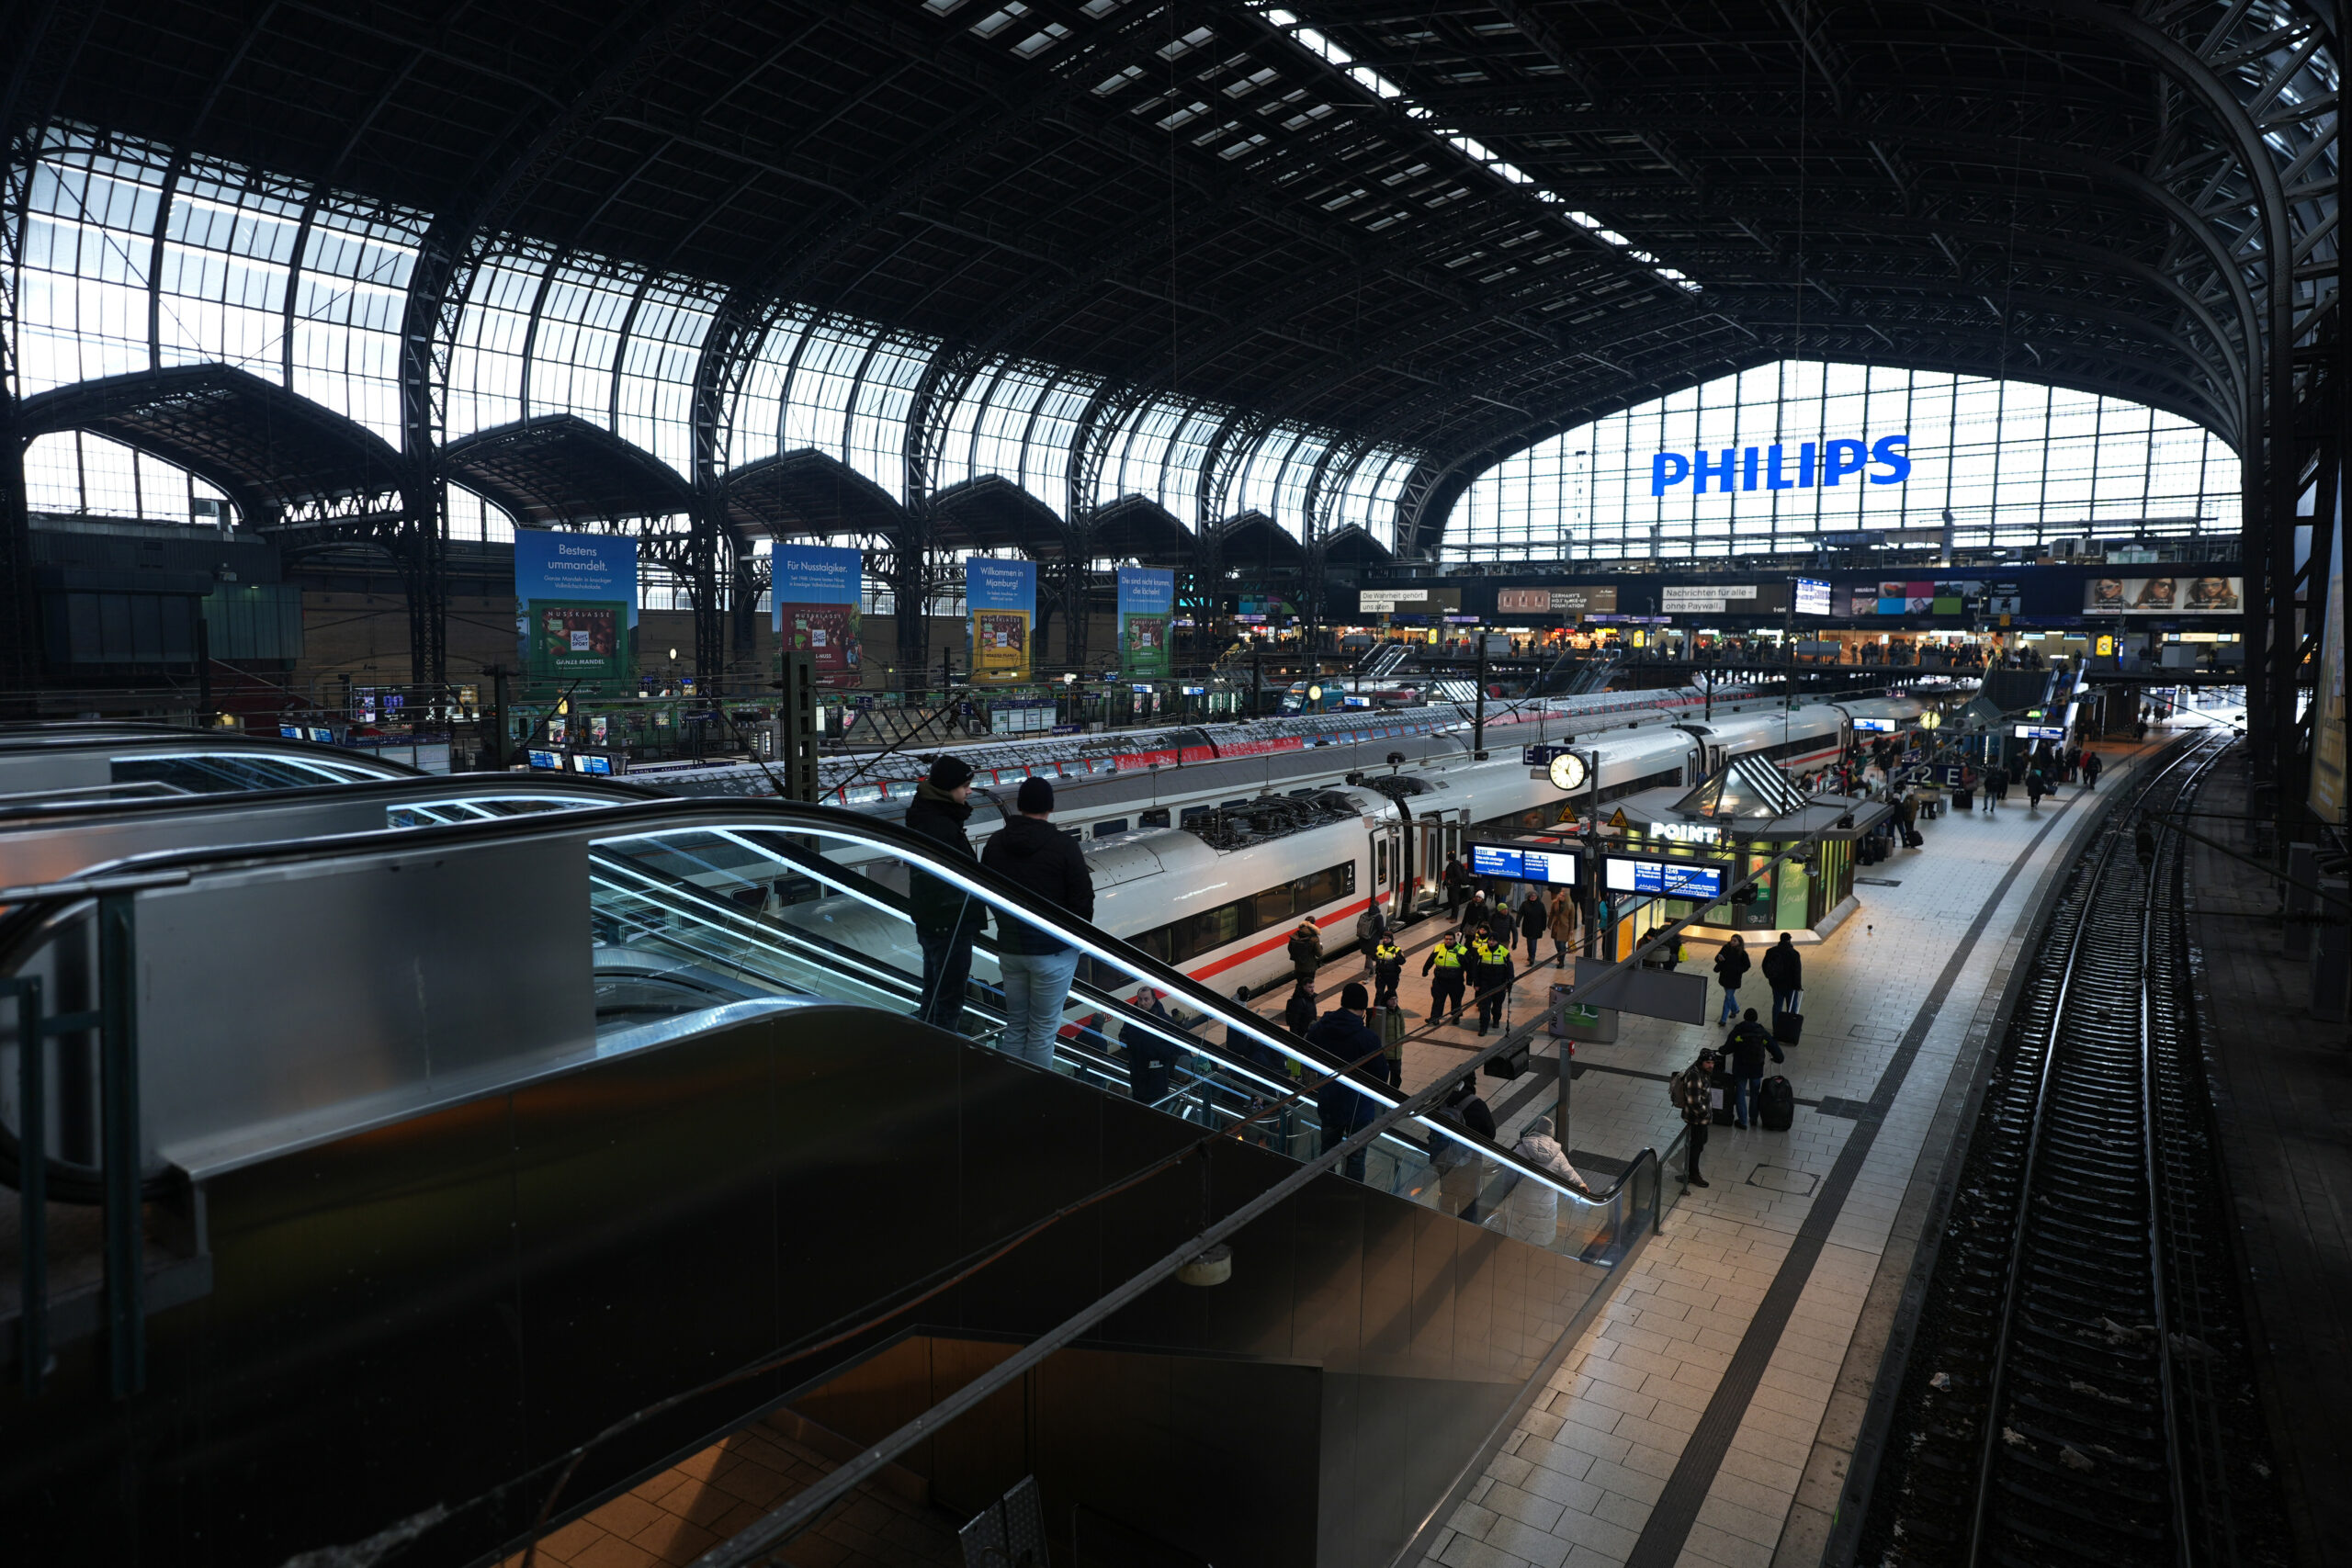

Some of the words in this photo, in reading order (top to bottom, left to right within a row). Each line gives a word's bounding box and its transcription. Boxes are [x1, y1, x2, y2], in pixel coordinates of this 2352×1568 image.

[1651, 434, 1911, 497] PHILIPS
[559, 544, 597, 557] Bestens
[548, 559, 608, 571] ummandelt.
[787, 560, 799, 570] Für
[800, 561, 848, 575] Nusstalgiker.
[979, 567, 1017, 578] Willkommen
[1018, 570, 1023, 578] in
[985, 579, 1019, 590] Mjamburg!
[1133, 587, 1141, 595] die
[1402, 592, 1423, 600] gehört
[1666, 589, 1716, 597] Nachrichten
[1717, 588, 1729, 596] für
[1687, 603, 1722, 612] Paywall.
[961, 704, 967, 715] E
[1524, 749, 1534, 763] E
[1907, 765, 1932, 784] 12
[1946, 768, 1961, 786] E
[1650, 821, 1718, 844] POINT
[1347, 864, 1353, 878] 2
